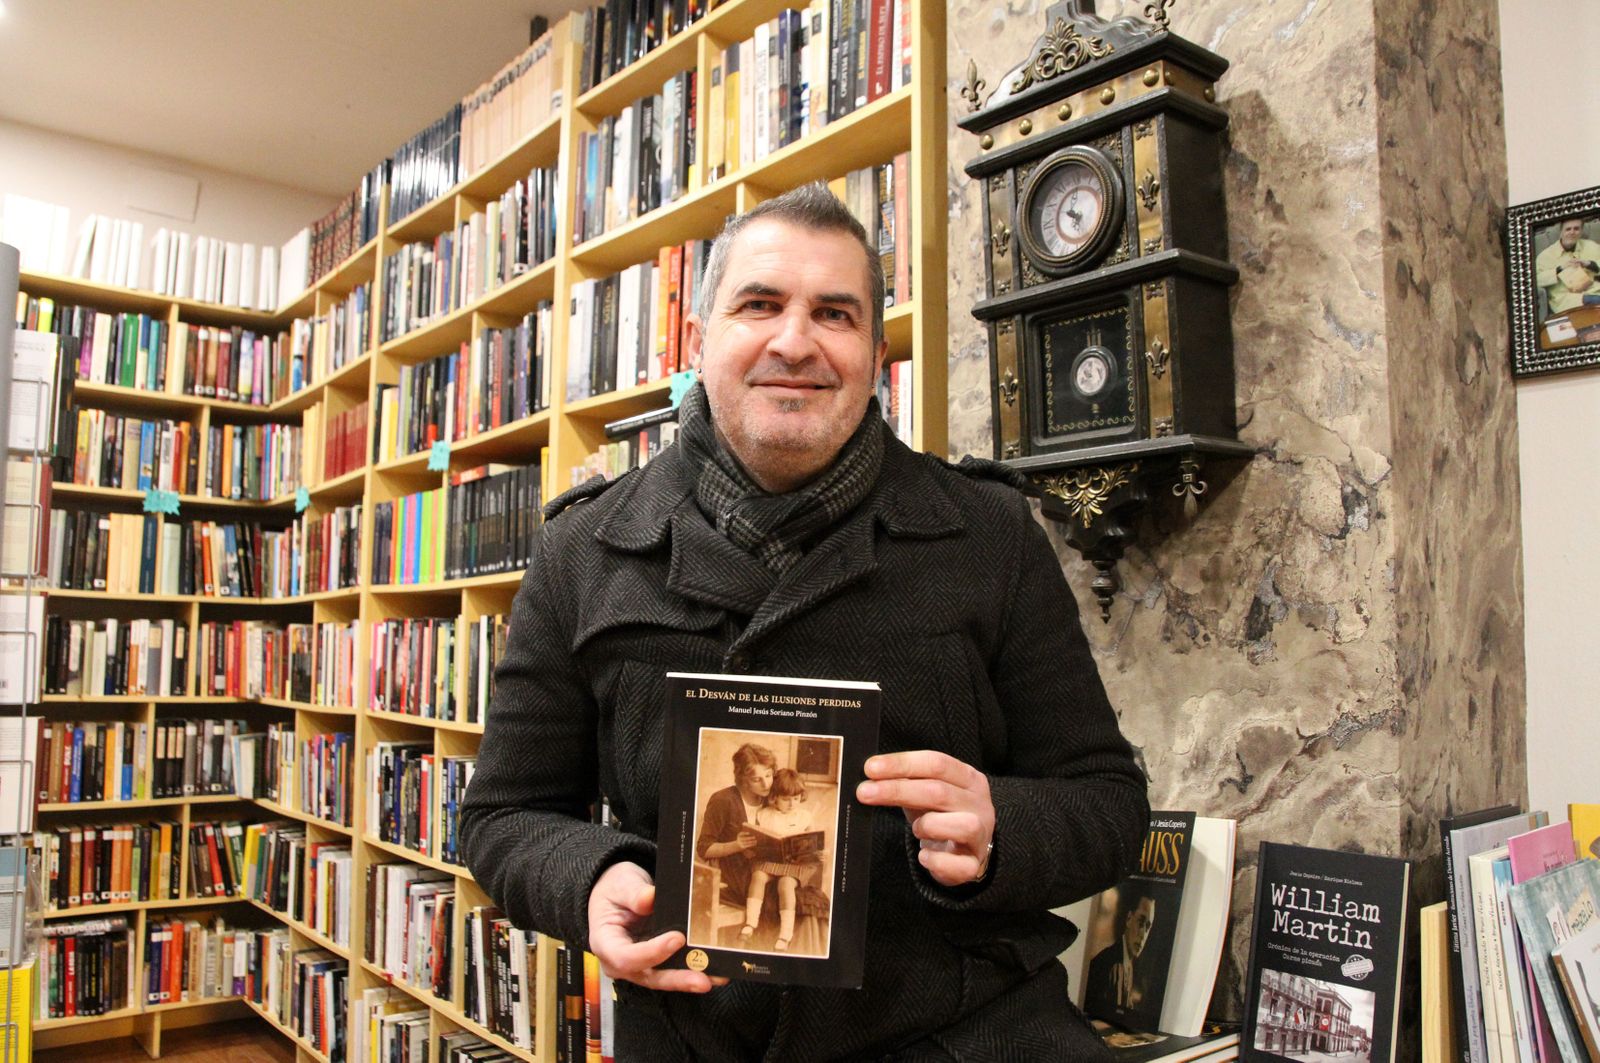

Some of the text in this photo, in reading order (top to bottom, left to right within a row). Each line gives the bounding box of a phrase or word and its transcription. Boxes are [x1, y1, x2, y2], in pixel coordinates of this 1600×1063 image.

[738, 692, 751, 701] DE
[753, 692, 769, 702] LAS
[772, 694, 816, 706] ILUSIONES
[818, 698, 862, 708] PERDIDAS
[728, 706, 818, 718] Manuel Jesús Soriano Pinzón
[1169, 820, 1186, 829] Copeiro
[1270, 882, 1381, 924] William
[1272, 910, 1374, 950] Martin
[1450, 914, 1458, 931] Javier
[1268, 942, 1291, 953] Crónica
[1308, 951, 1340, 962] operación
[1282, 953, 1323, 967] Carne picada
